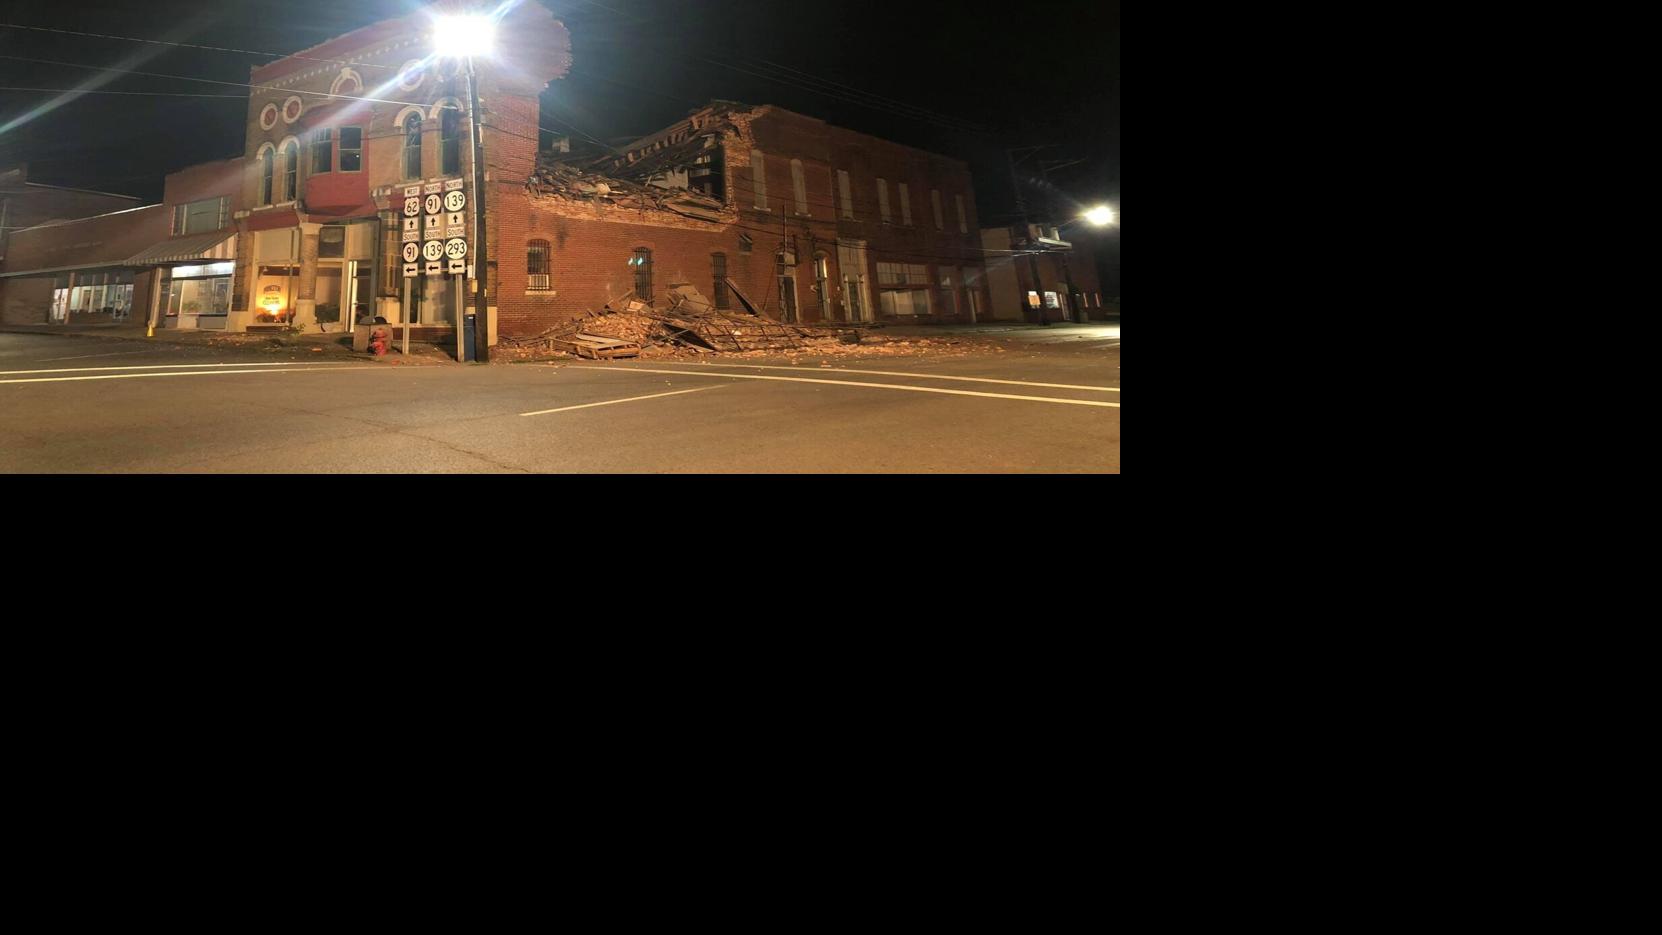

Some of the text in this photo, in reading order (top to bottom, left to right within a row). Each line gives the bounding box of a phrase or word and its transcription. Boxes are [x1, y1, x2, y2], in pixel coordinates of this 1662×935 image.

[428, 199, 437, 209] 91
[447, 195, 463, 207] 139
[407, 202, 417, 212] 62
[407, 247, 415, 257] 91
[426, 245, 442, 256] 139
[448, 242, 465, 255] 293
